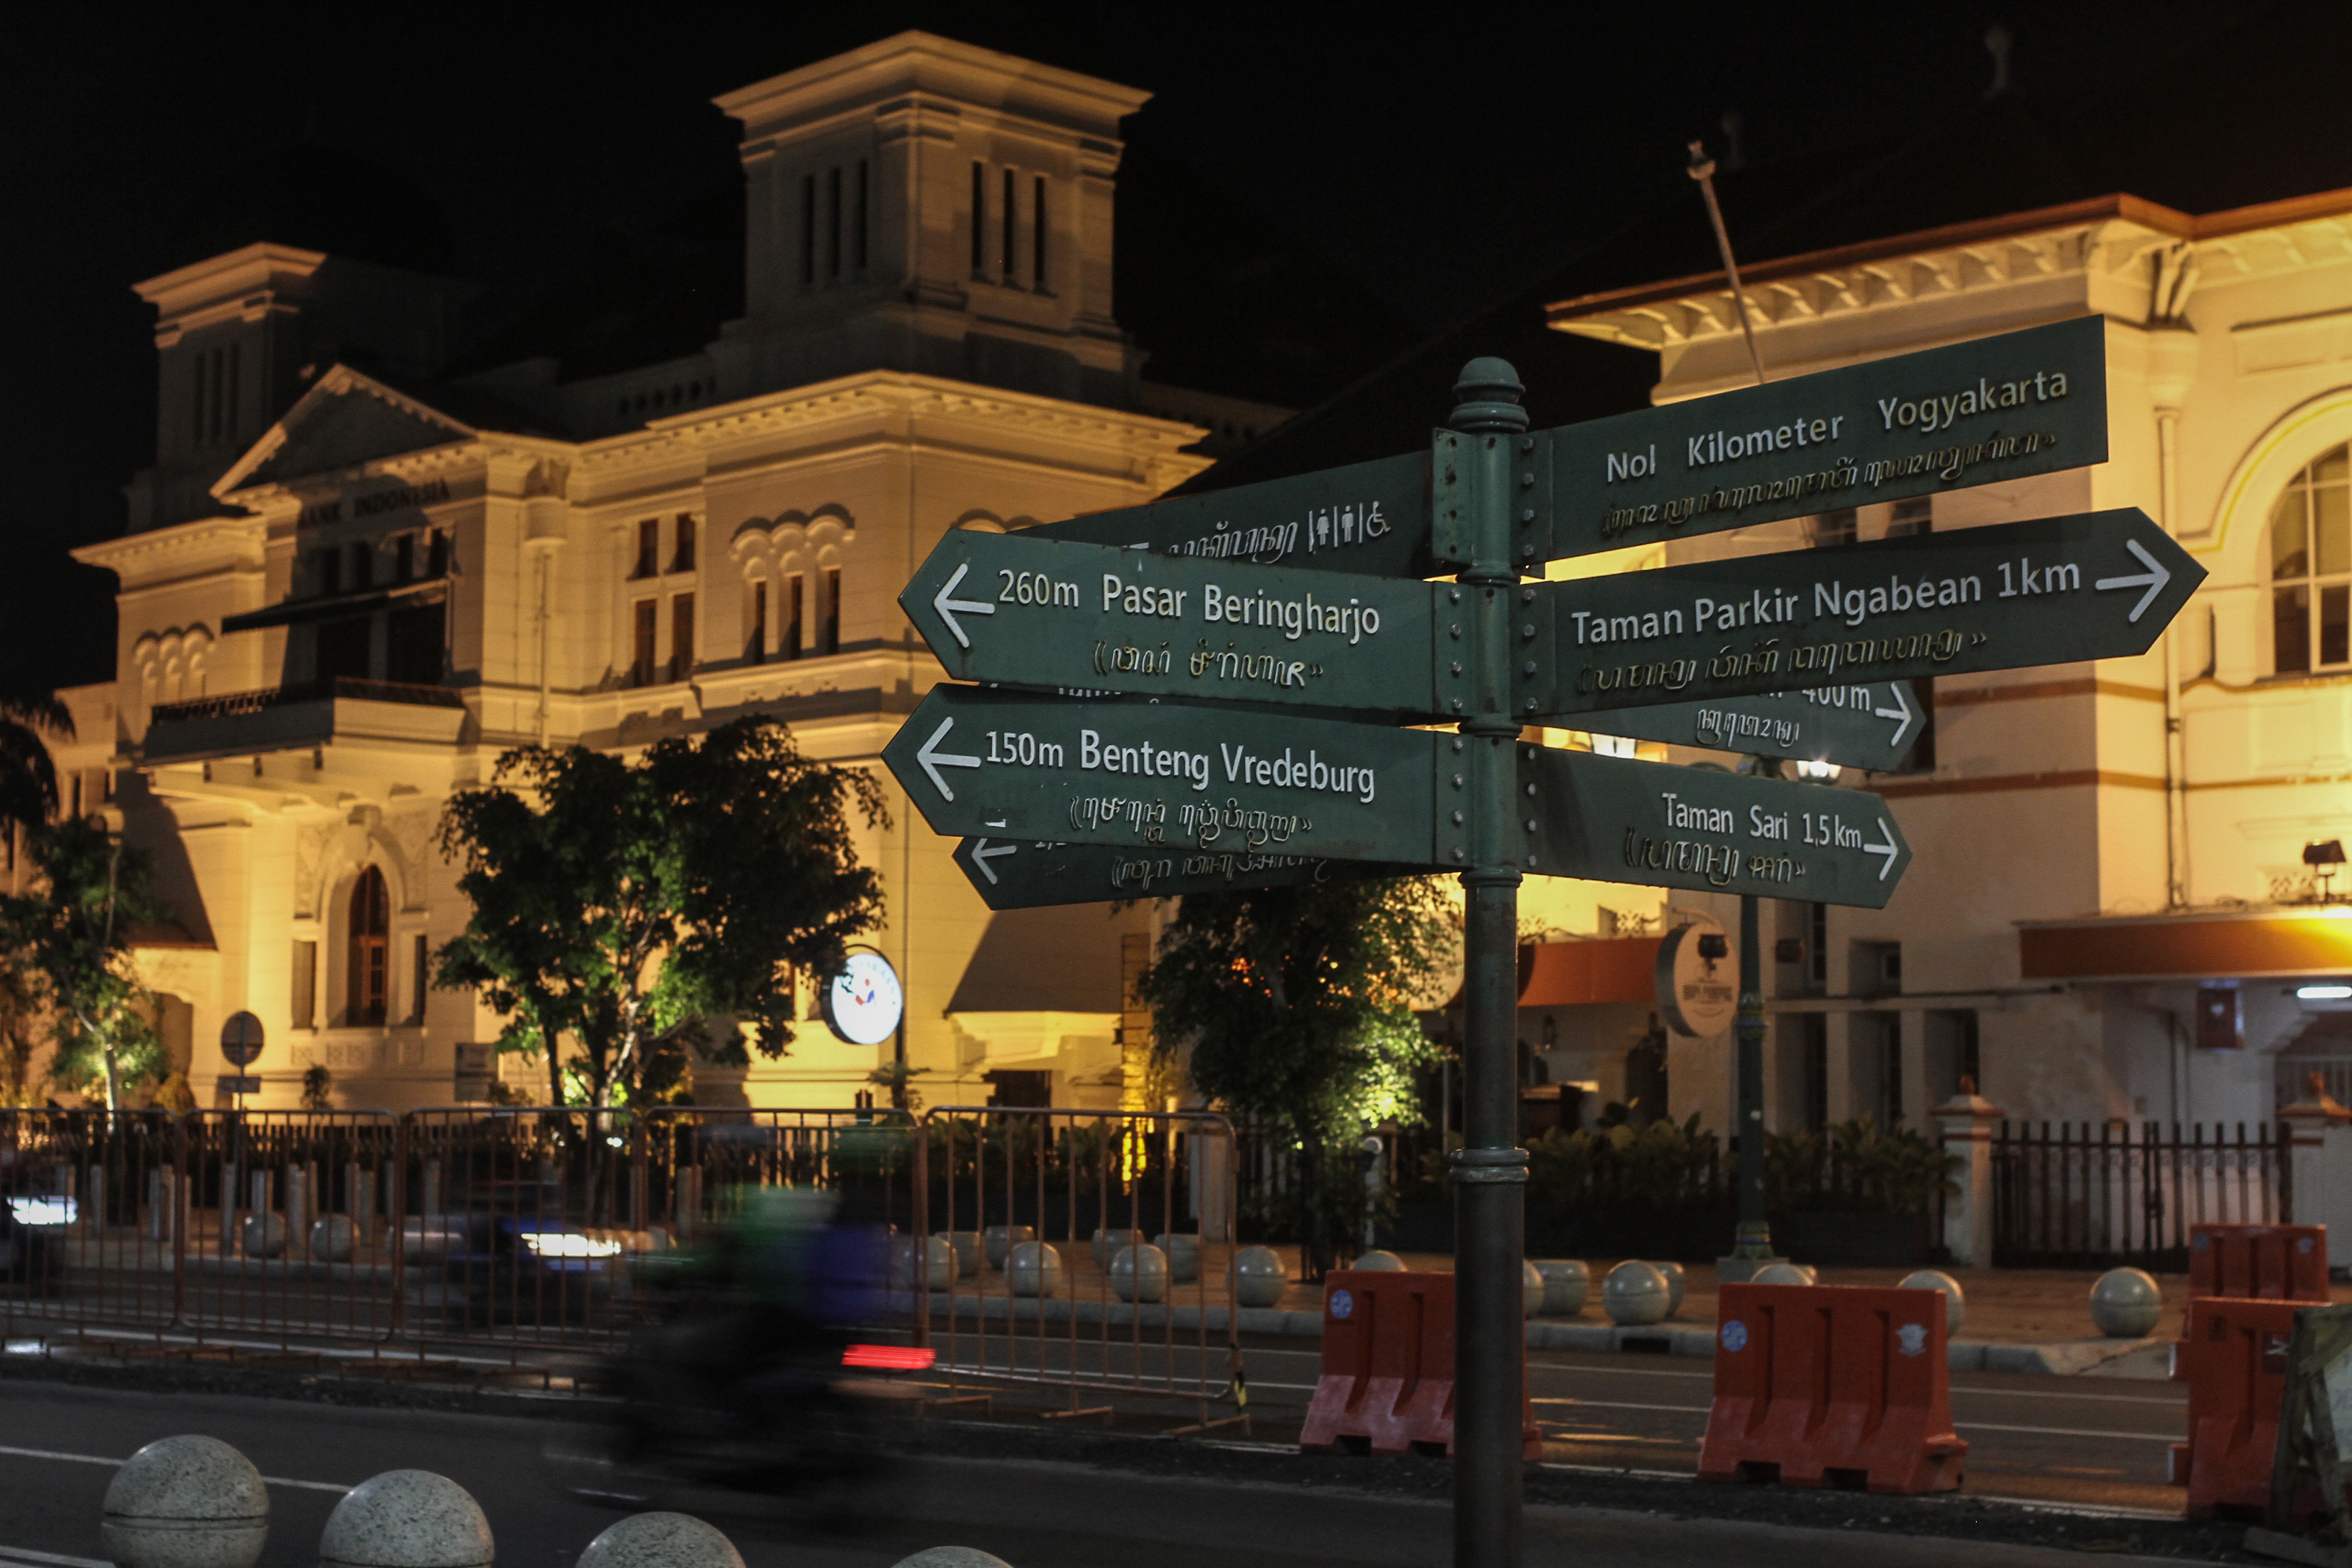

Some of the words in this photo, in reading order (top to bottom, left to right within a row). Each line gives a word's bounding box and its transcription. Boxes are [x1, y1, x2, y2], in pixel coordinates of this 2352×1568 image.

[1607, 443, 1656, 483] Nol
[1688, 412, 1843, 467] Kilometer
[1878, 371, 2068, 431] Yogyakarta
[998, 568, 1079, 608] 260m
[1102, 573, 1188, 617] Pasar
[1204, 583, 1380, 645] Beringharjo
[1571, 609, 1683, 644] Taman
[1694, 587, 1799, 633] Parkir
[1814, 576, 1981, 626] Ngabean
[1999, 557, 2080, 598] 1km
[985, 730, 1064, 768] 150m
[1080, 729, 1209, 791] Benteng
[1220, 742, 1375, 804] Vredeburg
[1661, 791, 1734, 834] Taman
[1749, 804, 1788, 840] Sari
